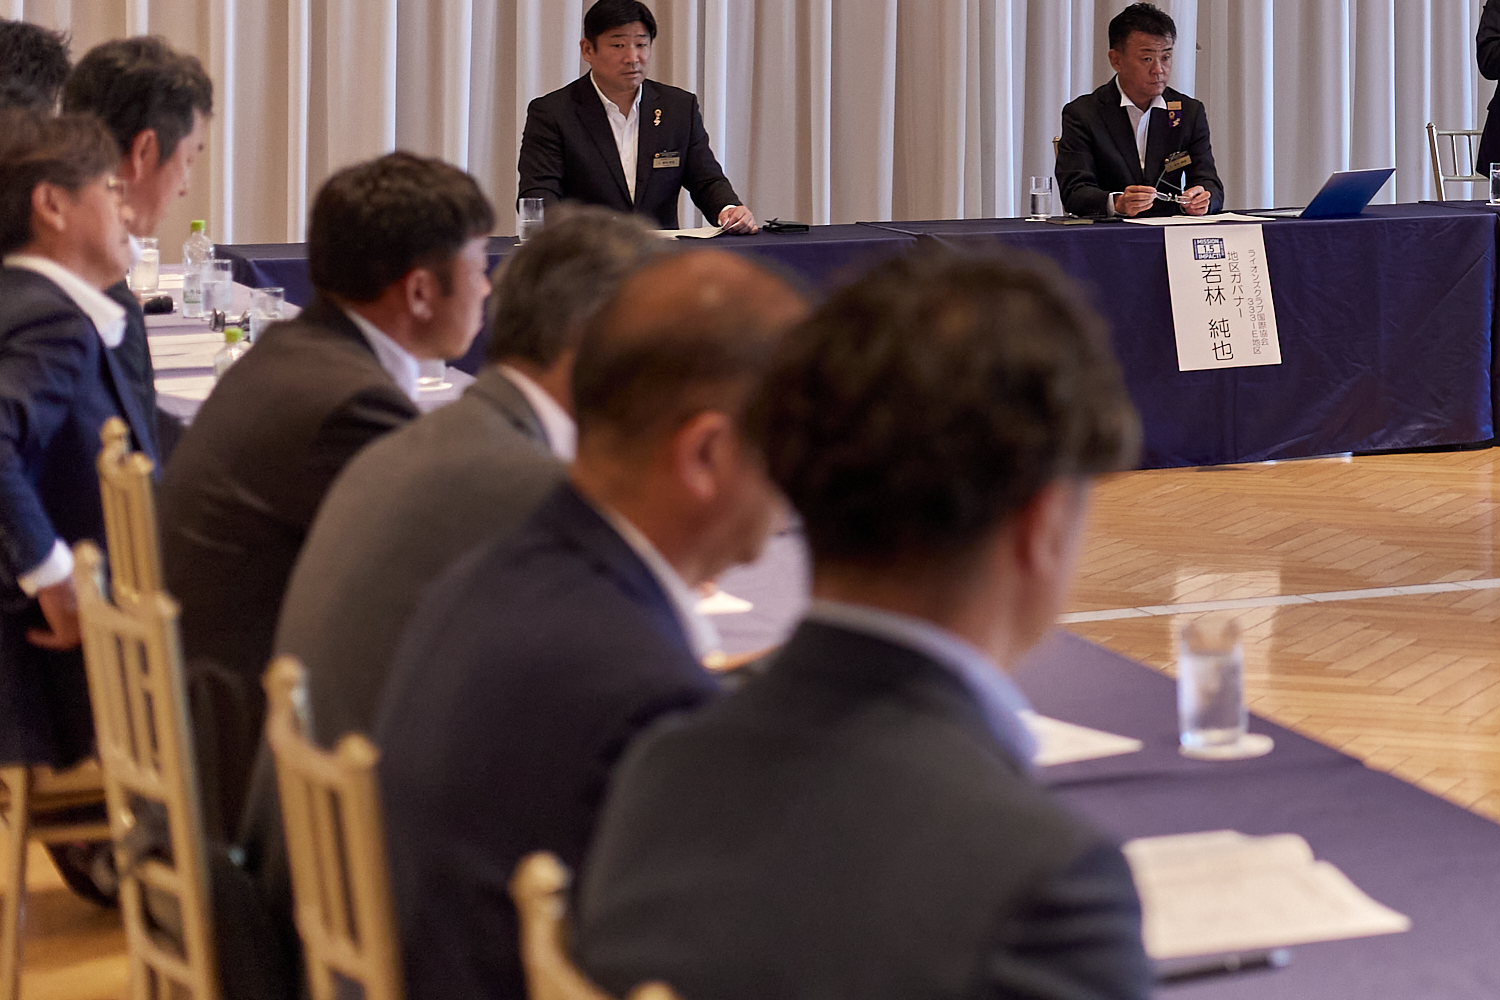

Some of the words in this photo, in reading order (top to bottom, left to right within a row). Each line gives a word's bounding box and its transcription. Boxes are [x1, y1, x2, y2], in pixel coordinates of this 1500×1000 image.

[1201, 263, 1226, 306] 若林
[1227, 251, 1245, 318] 地区ガバナー
[1208, 318, 1234, 361] 純也
